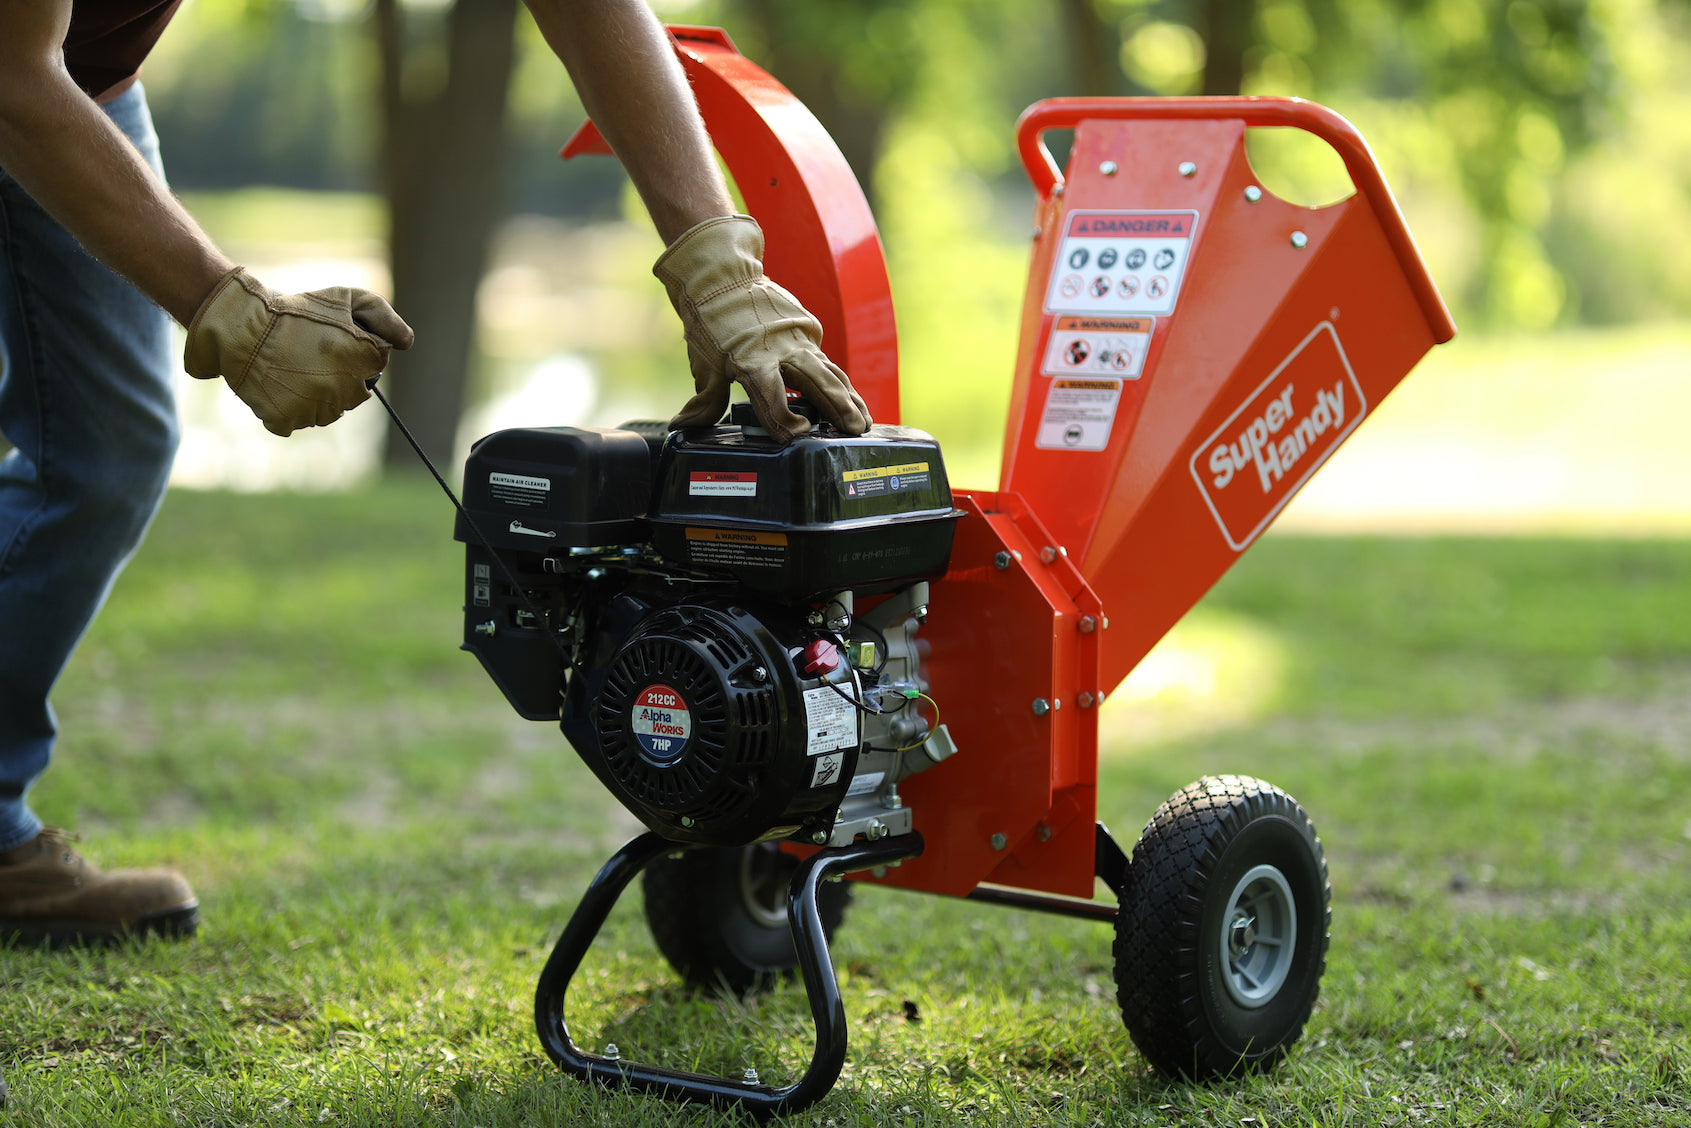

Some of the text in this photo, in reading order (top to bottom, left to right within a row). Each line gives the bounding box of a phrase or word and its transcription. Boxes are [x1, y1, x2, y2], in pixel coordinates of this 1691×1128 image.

[1092, 219, 1170, 233] DANGER
[1081, 321, 1139, 330] WARNING
[1209, 383, 1294, 490] Super
[1251, 379, 1345, 494] Handy
[492, 476, 515, 484] MAINTAIN
[525, 480, 547, 488] CLEANER
[722, 533, 757, 541] WARNING
[647, 693, 676, 706] 212CC
[640, 708, 671, 725] Alpha
[652, 722, 684, 736] WORKS
[651, 738, 672, 751] 7HP
